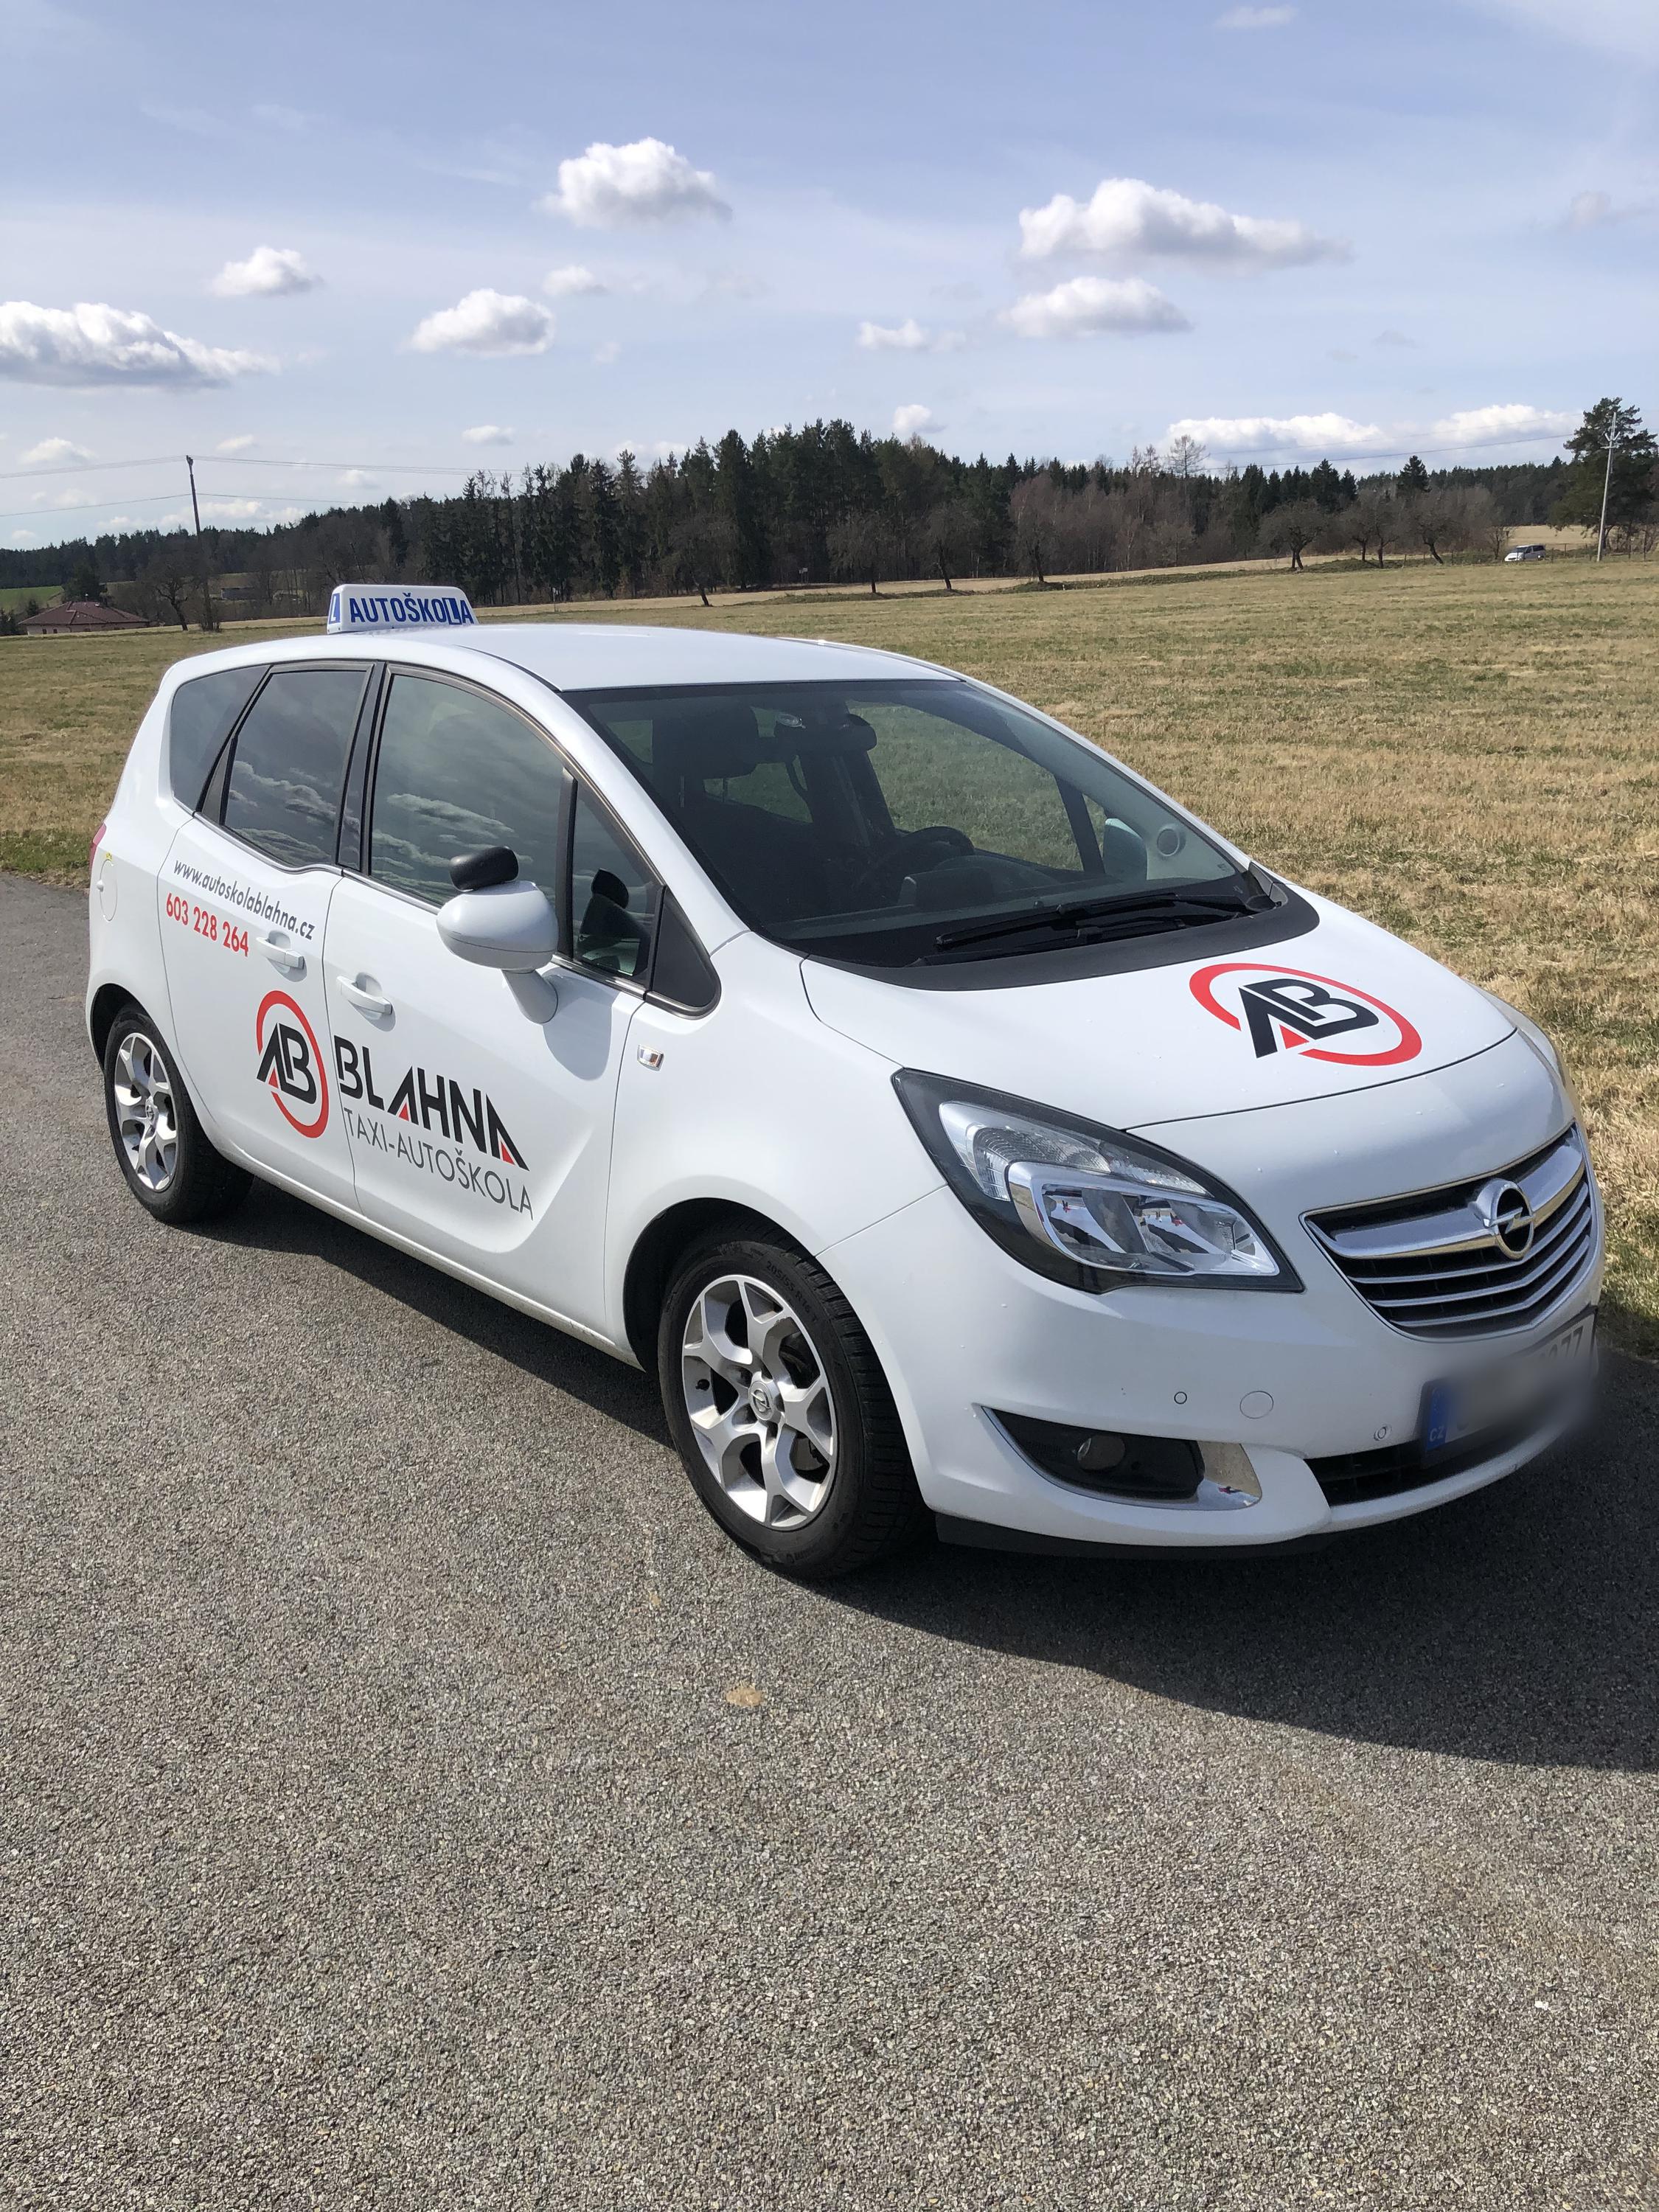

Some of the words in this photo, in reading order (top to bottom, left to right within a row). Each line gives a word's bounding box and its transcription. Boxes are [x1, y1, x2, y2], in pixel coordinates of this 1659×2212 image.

[349, 592, 474, 625] AUTOŠKOLA
[166, 892, 189, 925] 603
[193, 906, 218, 942] 228
[223, 921, 249, 957] 264
[173, 860, 316, 941] www.autoskolablahna.cz
[1238, 978, 1380, 1059] AB
[257, 1022, 317, 1105] AB
[333, 1034, 530, 1172] BLAHNA
[344, 1107, 534, 1221] TAXI-AUTOŠKOLA
[1429, 1425, 1444, 1442] CZ
